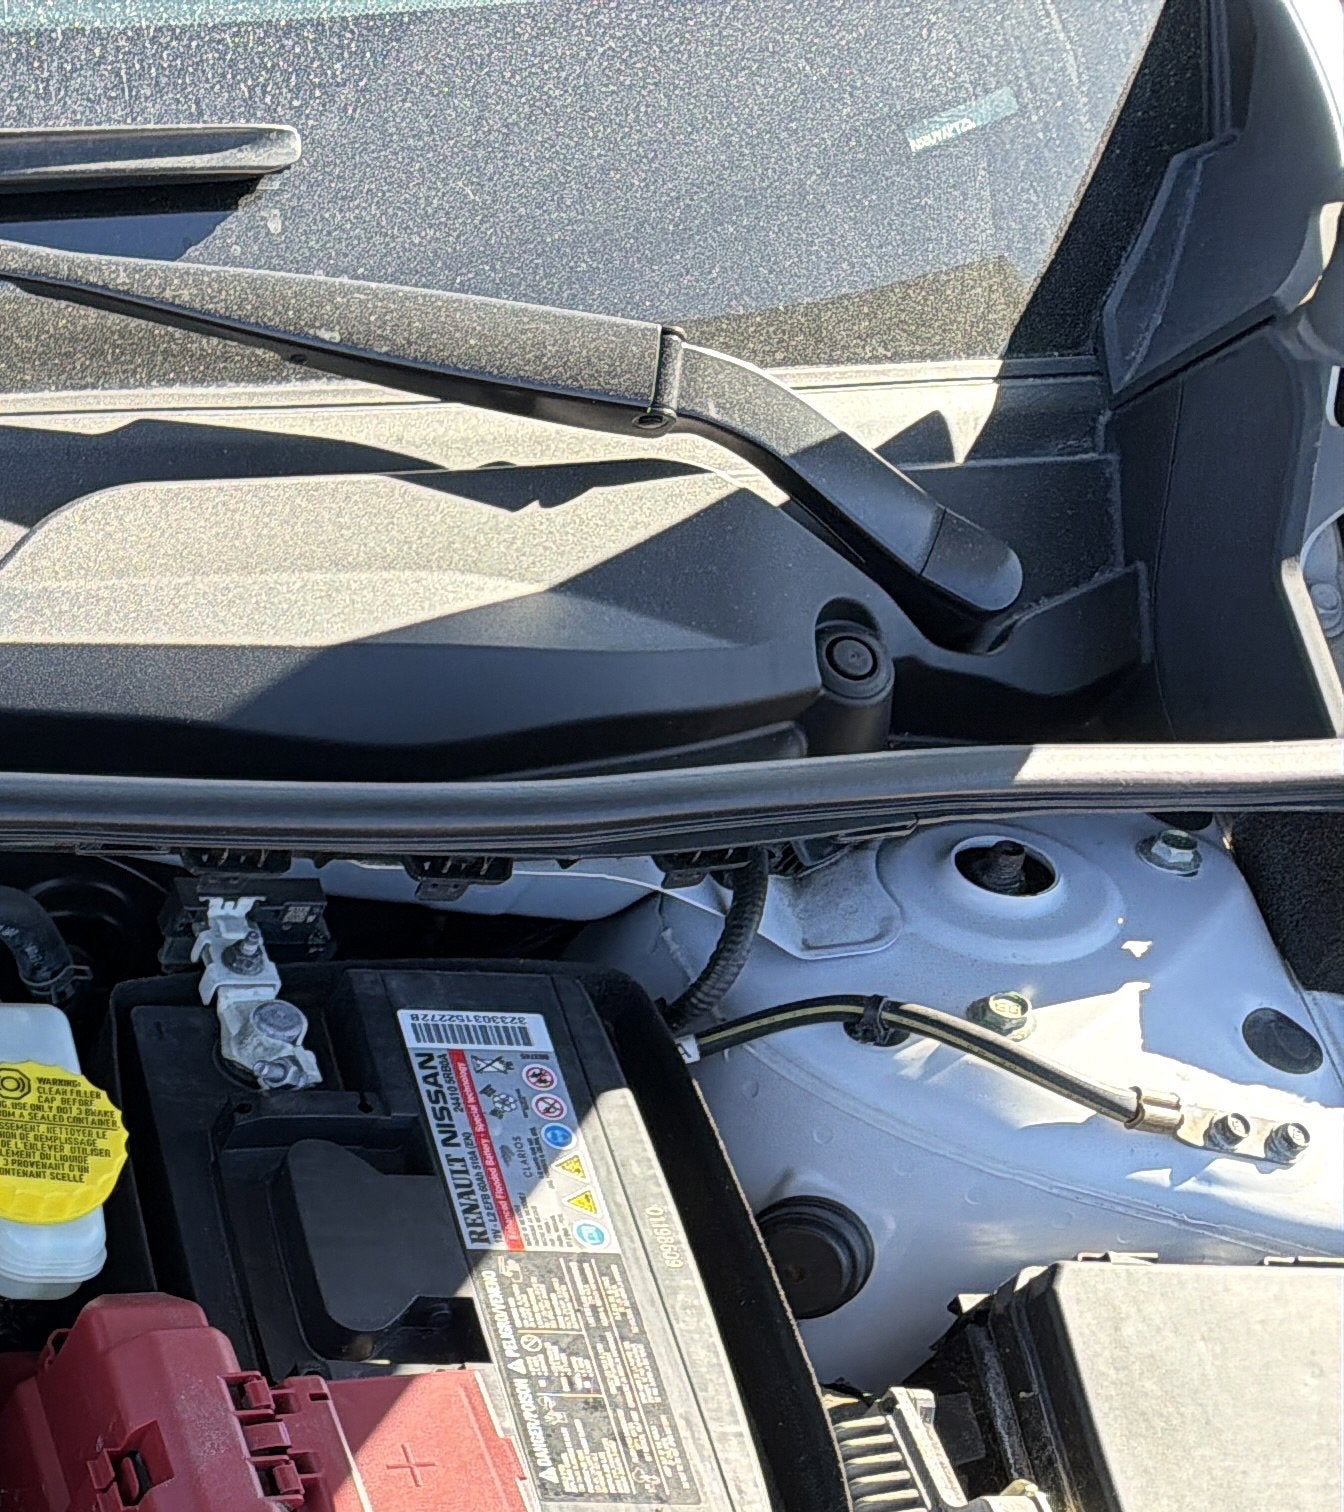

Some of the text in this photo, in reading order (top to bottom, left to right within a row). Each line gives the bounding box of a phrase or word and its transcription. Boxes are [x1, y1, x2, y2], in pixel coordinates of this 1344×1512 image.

[36, 1087, 101, 1099] CLEAN FILLER
[37, 1096, 95, 1107] CAP BEFORE
[449, 1085, 464, 1112] 24410
[12, 1101, 29, 1110] USE
[30, 1103, 54, 1113] ONLY
[57, 1106, 74, 1115] DOT
[85, 1109, 115, 1118] BRAKE
[18, 1111, 25, 1119] A
[27, 1112, 65, 1124] SEALED
[19, 1133, 31, 1142] DE
[33, 1134, 98, 1148] REMPLISSAGE
[46, 1126, 95, 1138] NETTOYER
[96, 1130, 108, 1140] LE
[0, 1139, 12, 1148] DE
[70, 1147, 111, 1158] UTILISER
[415, 1051, 491, 1244] RENAULT NISSAN
[456, 1061, 517, 1239] Enhanced Flooded Battery Special technology
[513, 1134, 532, 1177] CLARIOS
[3, 1158, 9, 1166] 3
[11, 1159, 66, 1171] PROVENANT
[40, 1152, 52, 1160] DU
[54, 1154, 89, 1165] LIQUIDE
[475, 1170, 489, 1191] 60Ah
[482, 1192, 494, 1209] EFB
[482, 1268, 521, 1356] PELIGRO/VENENO
[512, 1377, 554, 1465] DANGER/POISON
